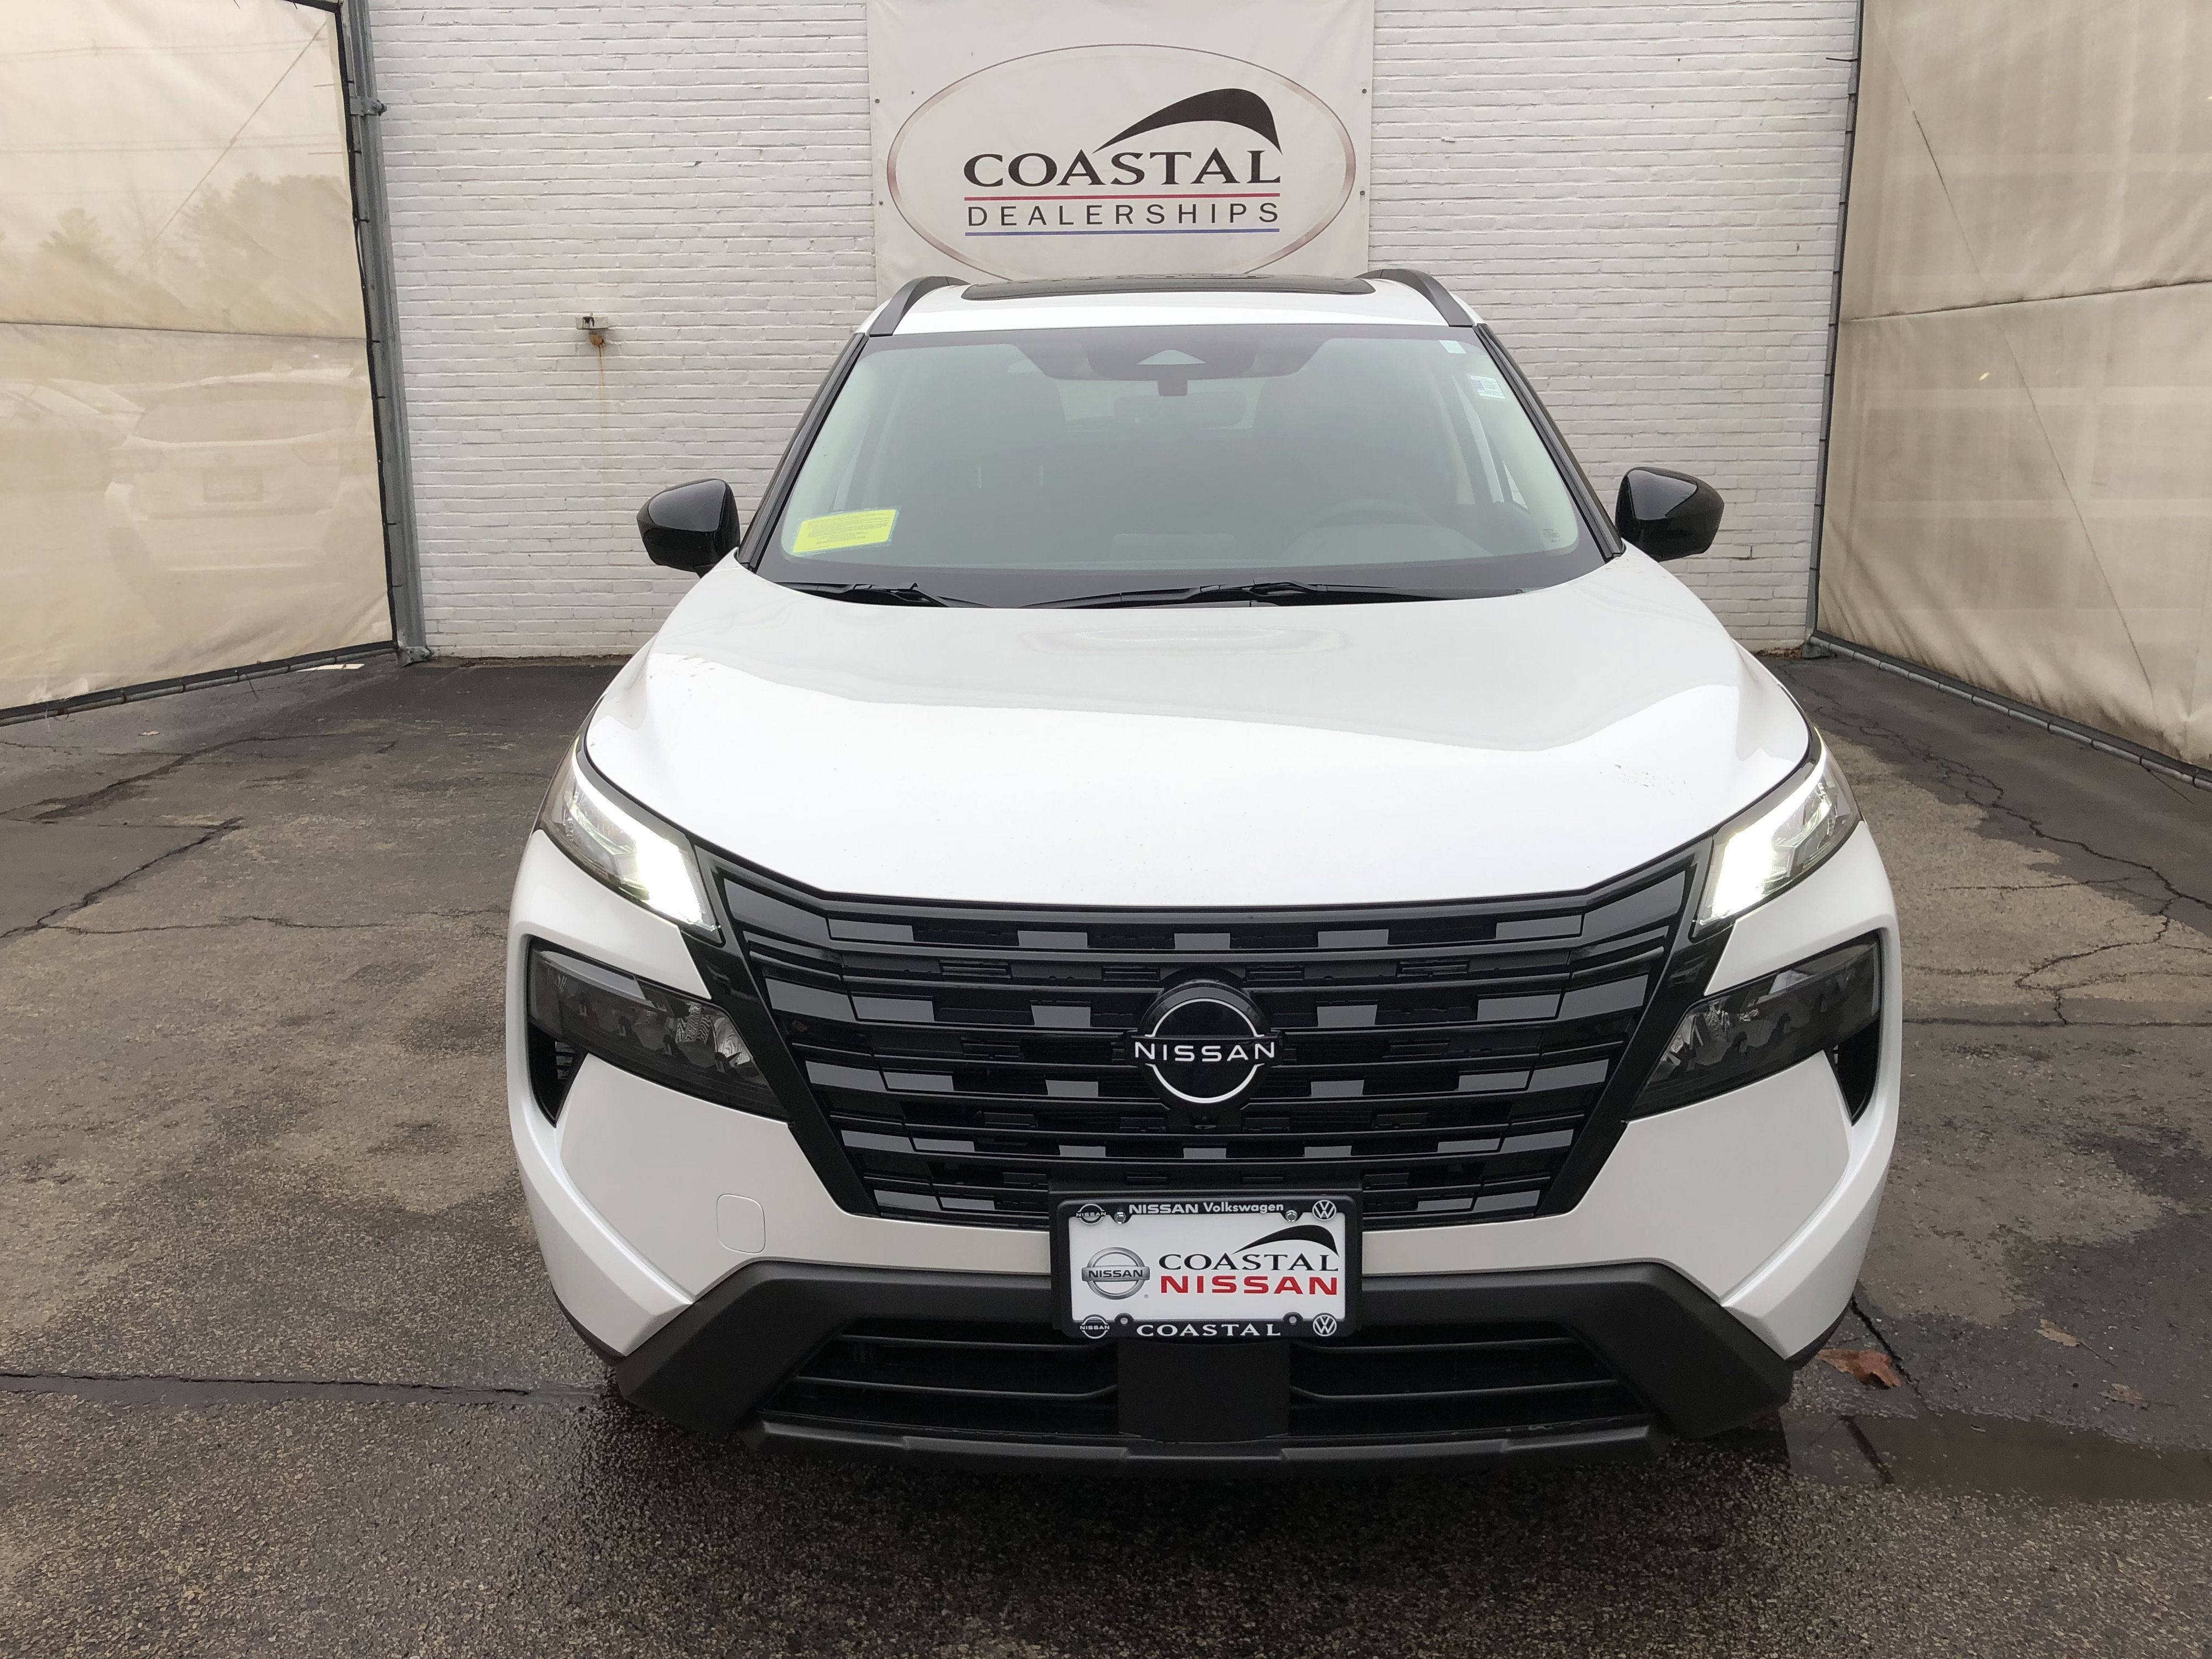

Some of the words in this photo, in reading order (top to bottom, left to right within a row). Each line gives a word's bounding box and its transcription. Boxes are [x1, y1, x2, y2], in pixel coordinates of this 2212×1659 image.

[963, 146, 1281, 187] COASTAL
[968, 202, 1278, 226] DEALERSHIPS
[1135, 1041, 1275, 1062] NISSAN
[1129, 1203, 1199, 1214] NISSAN
[1203, 1201, 1284, 1214] Volkswagen
[1159, 1252, 1339, 1272] COASTAL
[1088, 1269, 1143, 1279] NISSAN
[1160, 1275, 1338, 1295] NISSAN
[1136, 1323, 1281, 1336] COASTAL
